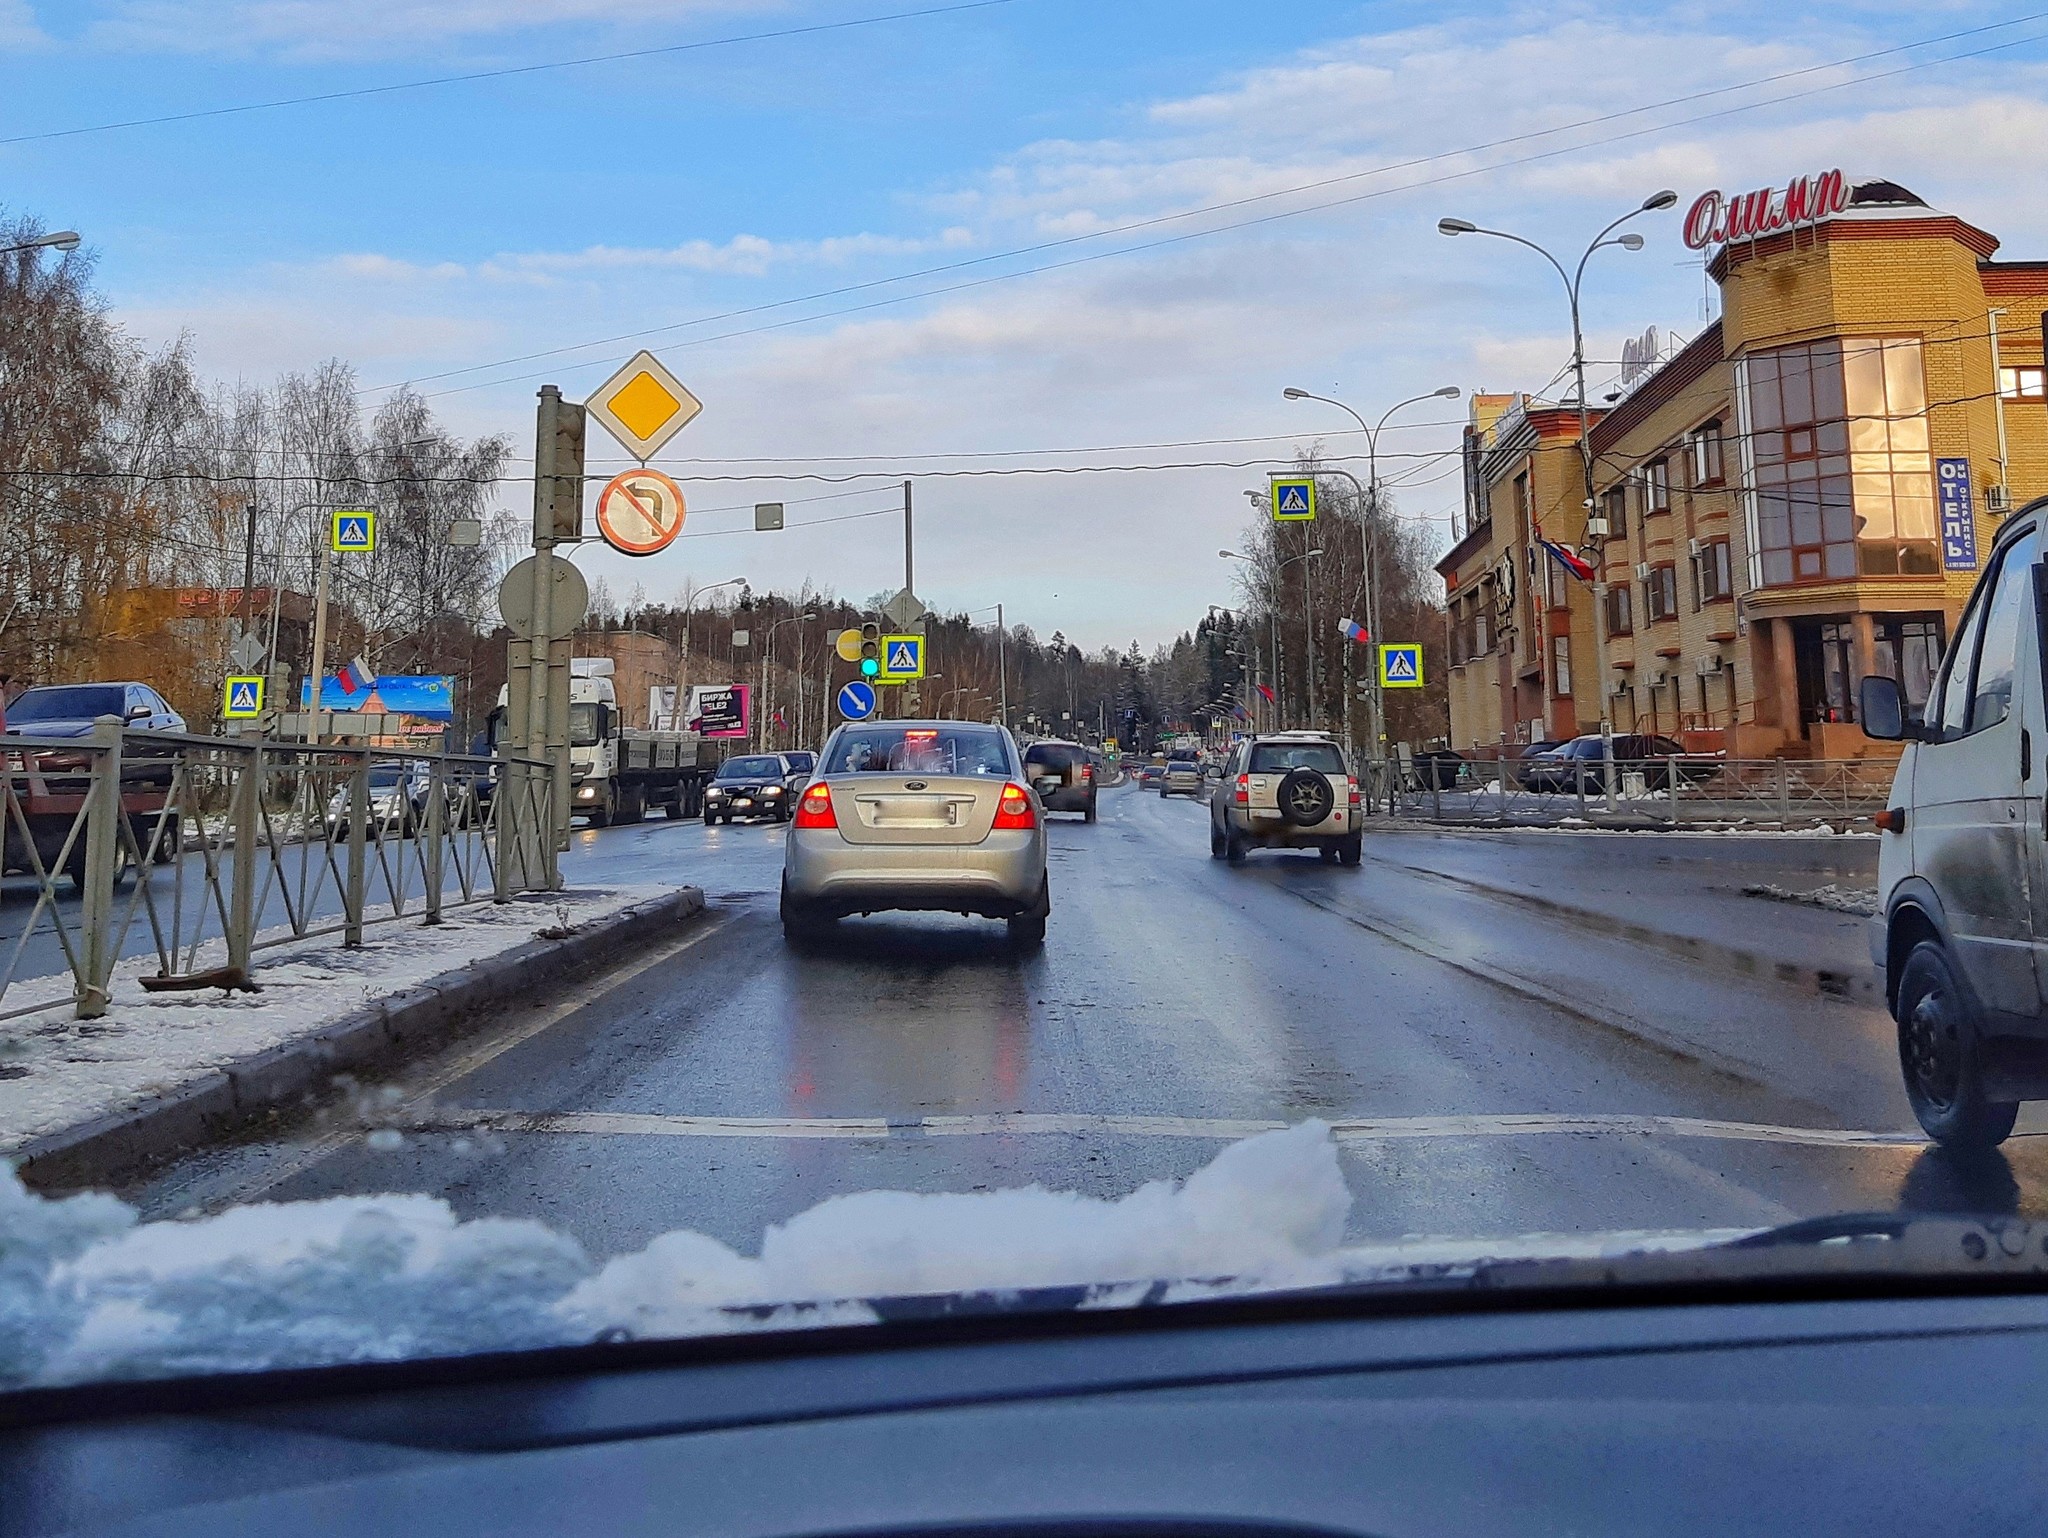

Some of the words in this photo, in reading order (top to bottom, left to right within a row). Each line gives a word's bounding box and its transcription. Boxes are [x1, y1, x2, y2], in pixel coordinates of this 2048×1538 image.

[1683, 168, 1850, 250] Олимп
[1957, 464, 1967, 479] МЫ
[1940, 463, 1963, 558] ОТЕЛЬ
[1959, 487, 1972, 556] ОТКРЫЛИСЬ
[701, 692, 733, 702] БИРЖА
